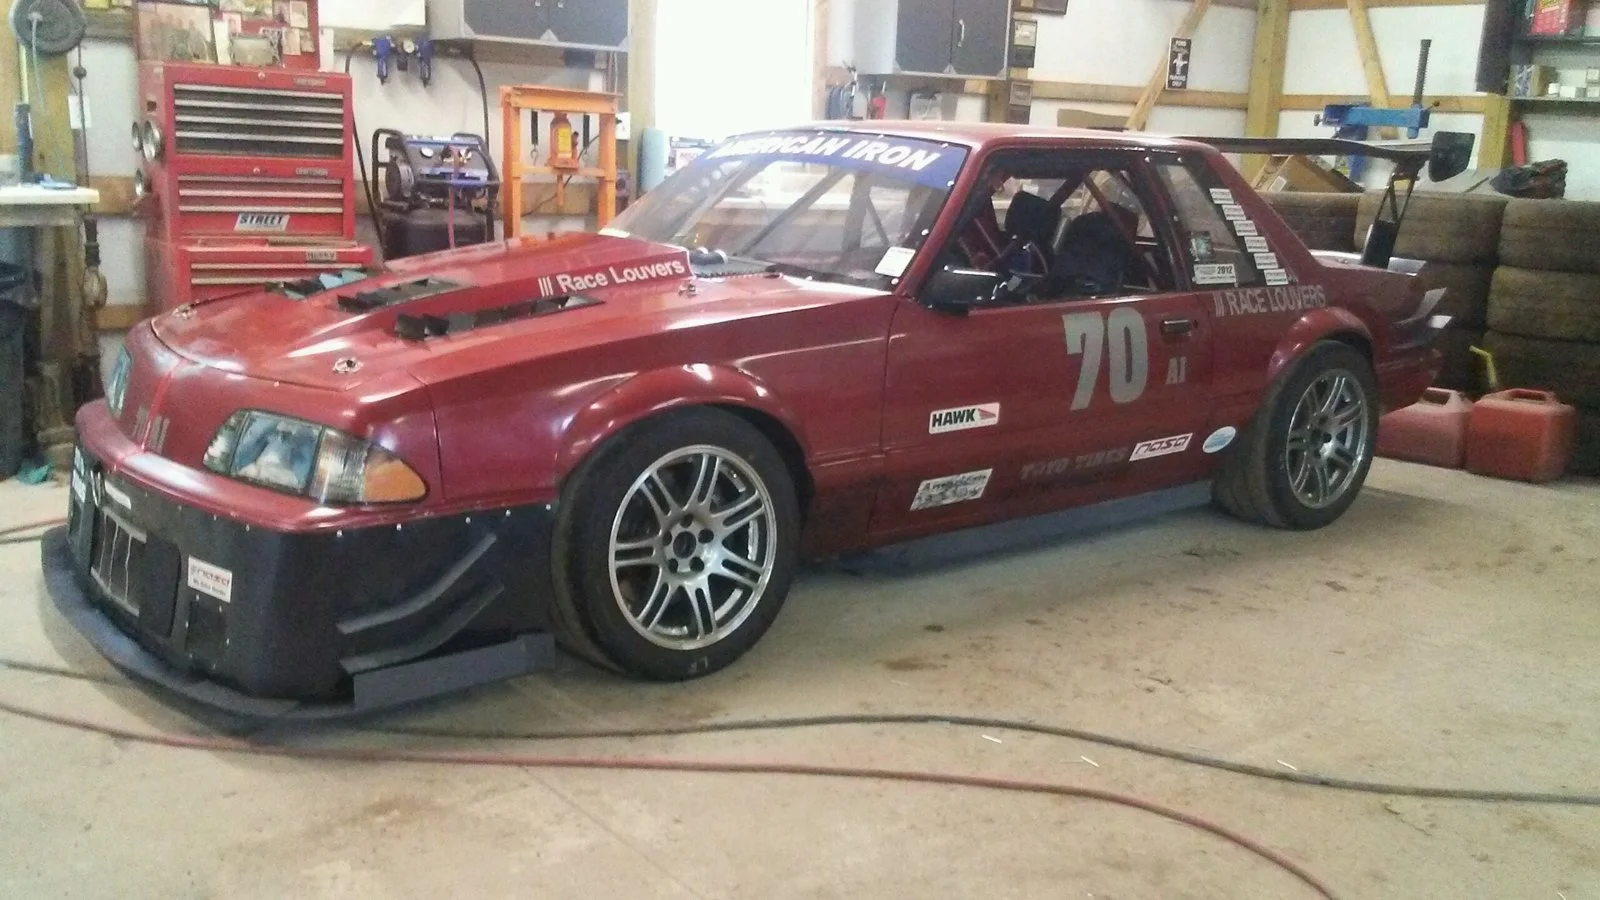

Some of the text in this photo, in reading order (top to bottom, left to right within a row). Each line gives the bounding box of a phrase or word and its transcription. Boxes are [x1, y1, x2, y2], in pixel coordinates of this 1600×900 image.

[706, 136, 940, 171] AMERICAN IRON
[239, 213, 284, 225] STREET
[556, 260, 685, 293] Race Louvers
[1217, 264, 1233, 275] 2012
[1224, 285, 1327, 316] RACE LOUVERS
[1062, 306, 1148, 411] 70
[932, 408, 976, 428] HAWK
